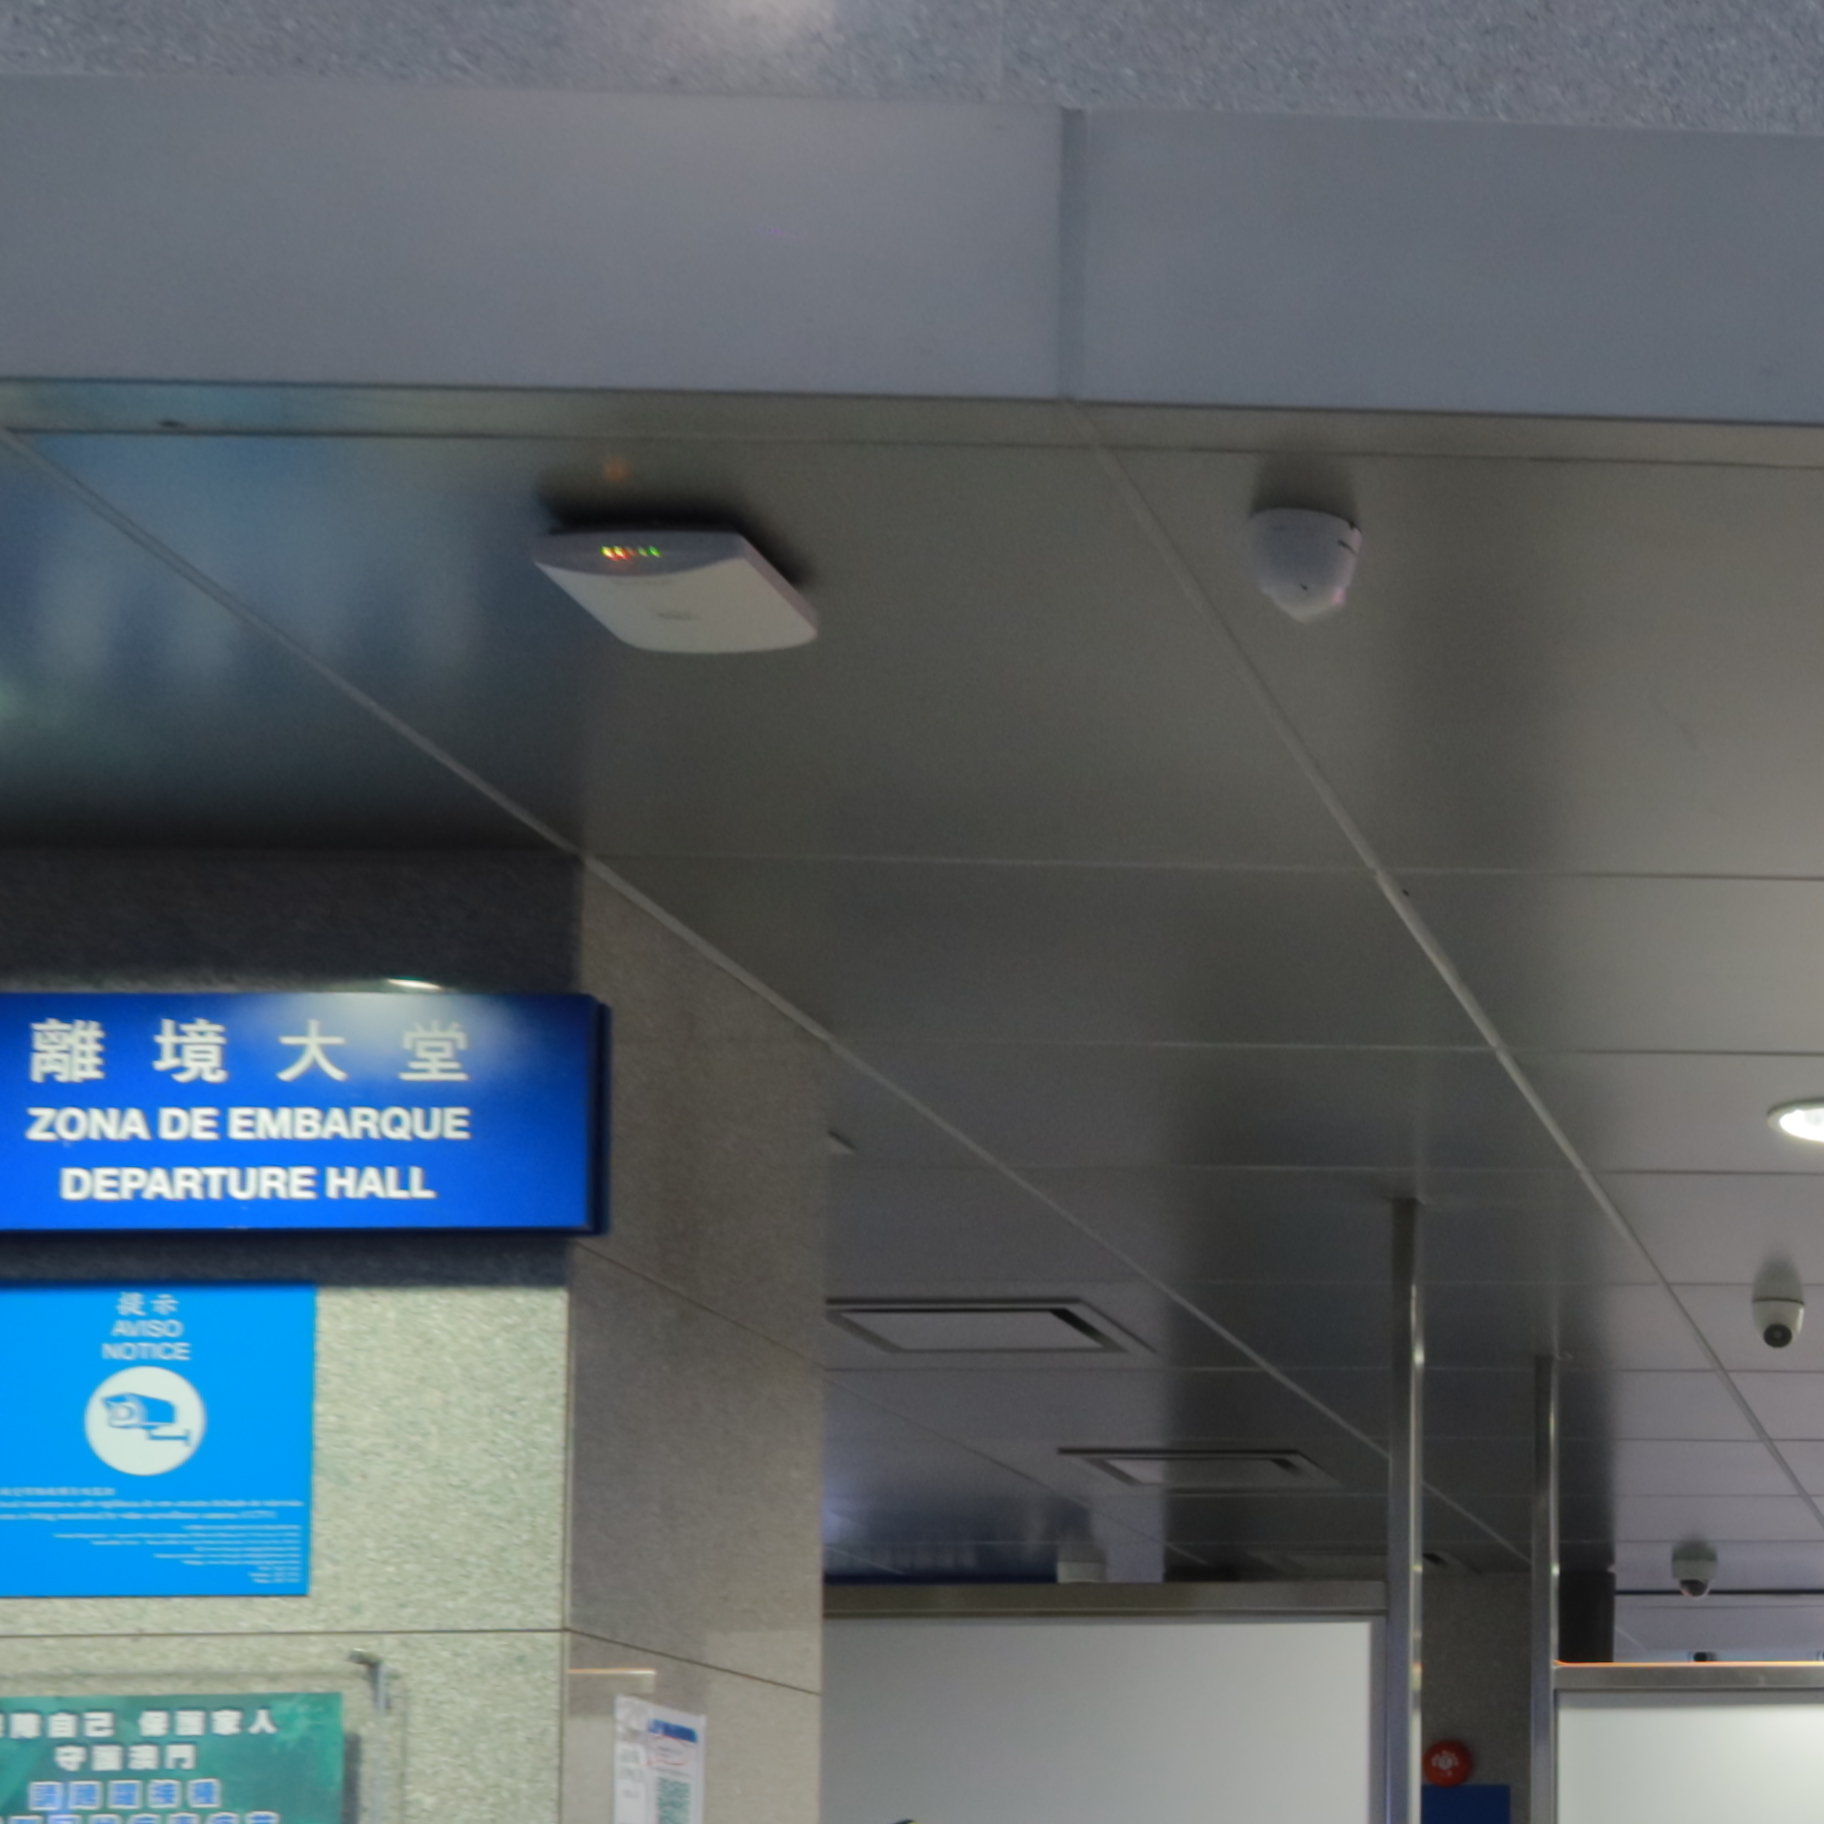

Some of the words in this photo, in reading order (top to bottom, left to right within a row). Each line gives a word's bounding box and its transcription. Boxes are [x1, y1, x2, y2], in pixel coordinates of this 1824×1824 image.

[29, 1019, 469, 1083] 離境大堂
[25, 1107, 151, 1142] ZONA
[158, 1107, 220, 1141] DE
[227, 1106, 471, 1141] EMBARQUE
[60, 1166, 317, 1200] DEPARTURE
[326, 1166, 436, 1199] HALL
[116, 1291, 180, 1316] 提示
[110, 1319, 185, 1338] AVISO
[101, 1341, 192, 1361] NOTICE
